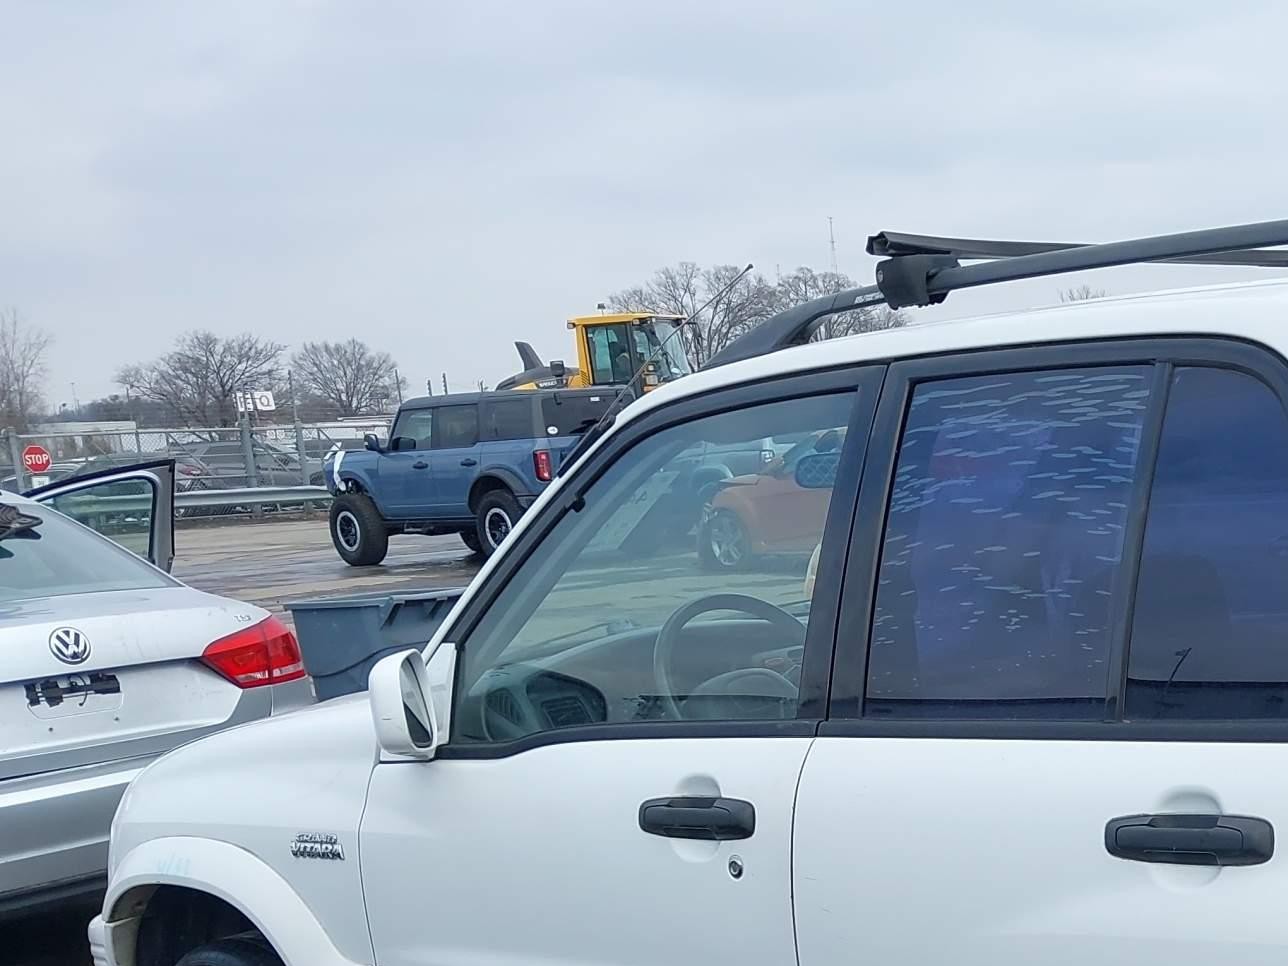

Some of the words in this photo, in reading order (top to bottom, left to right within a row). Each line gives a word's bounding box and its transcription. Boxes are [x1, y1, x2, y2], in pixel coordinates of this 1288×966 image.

[25, 454, 49, 465] STOP
[50, 628, 90, 663] VW
[296, 832, 338, 844] GRAND
[290, 841, 345, 860] VITARA
